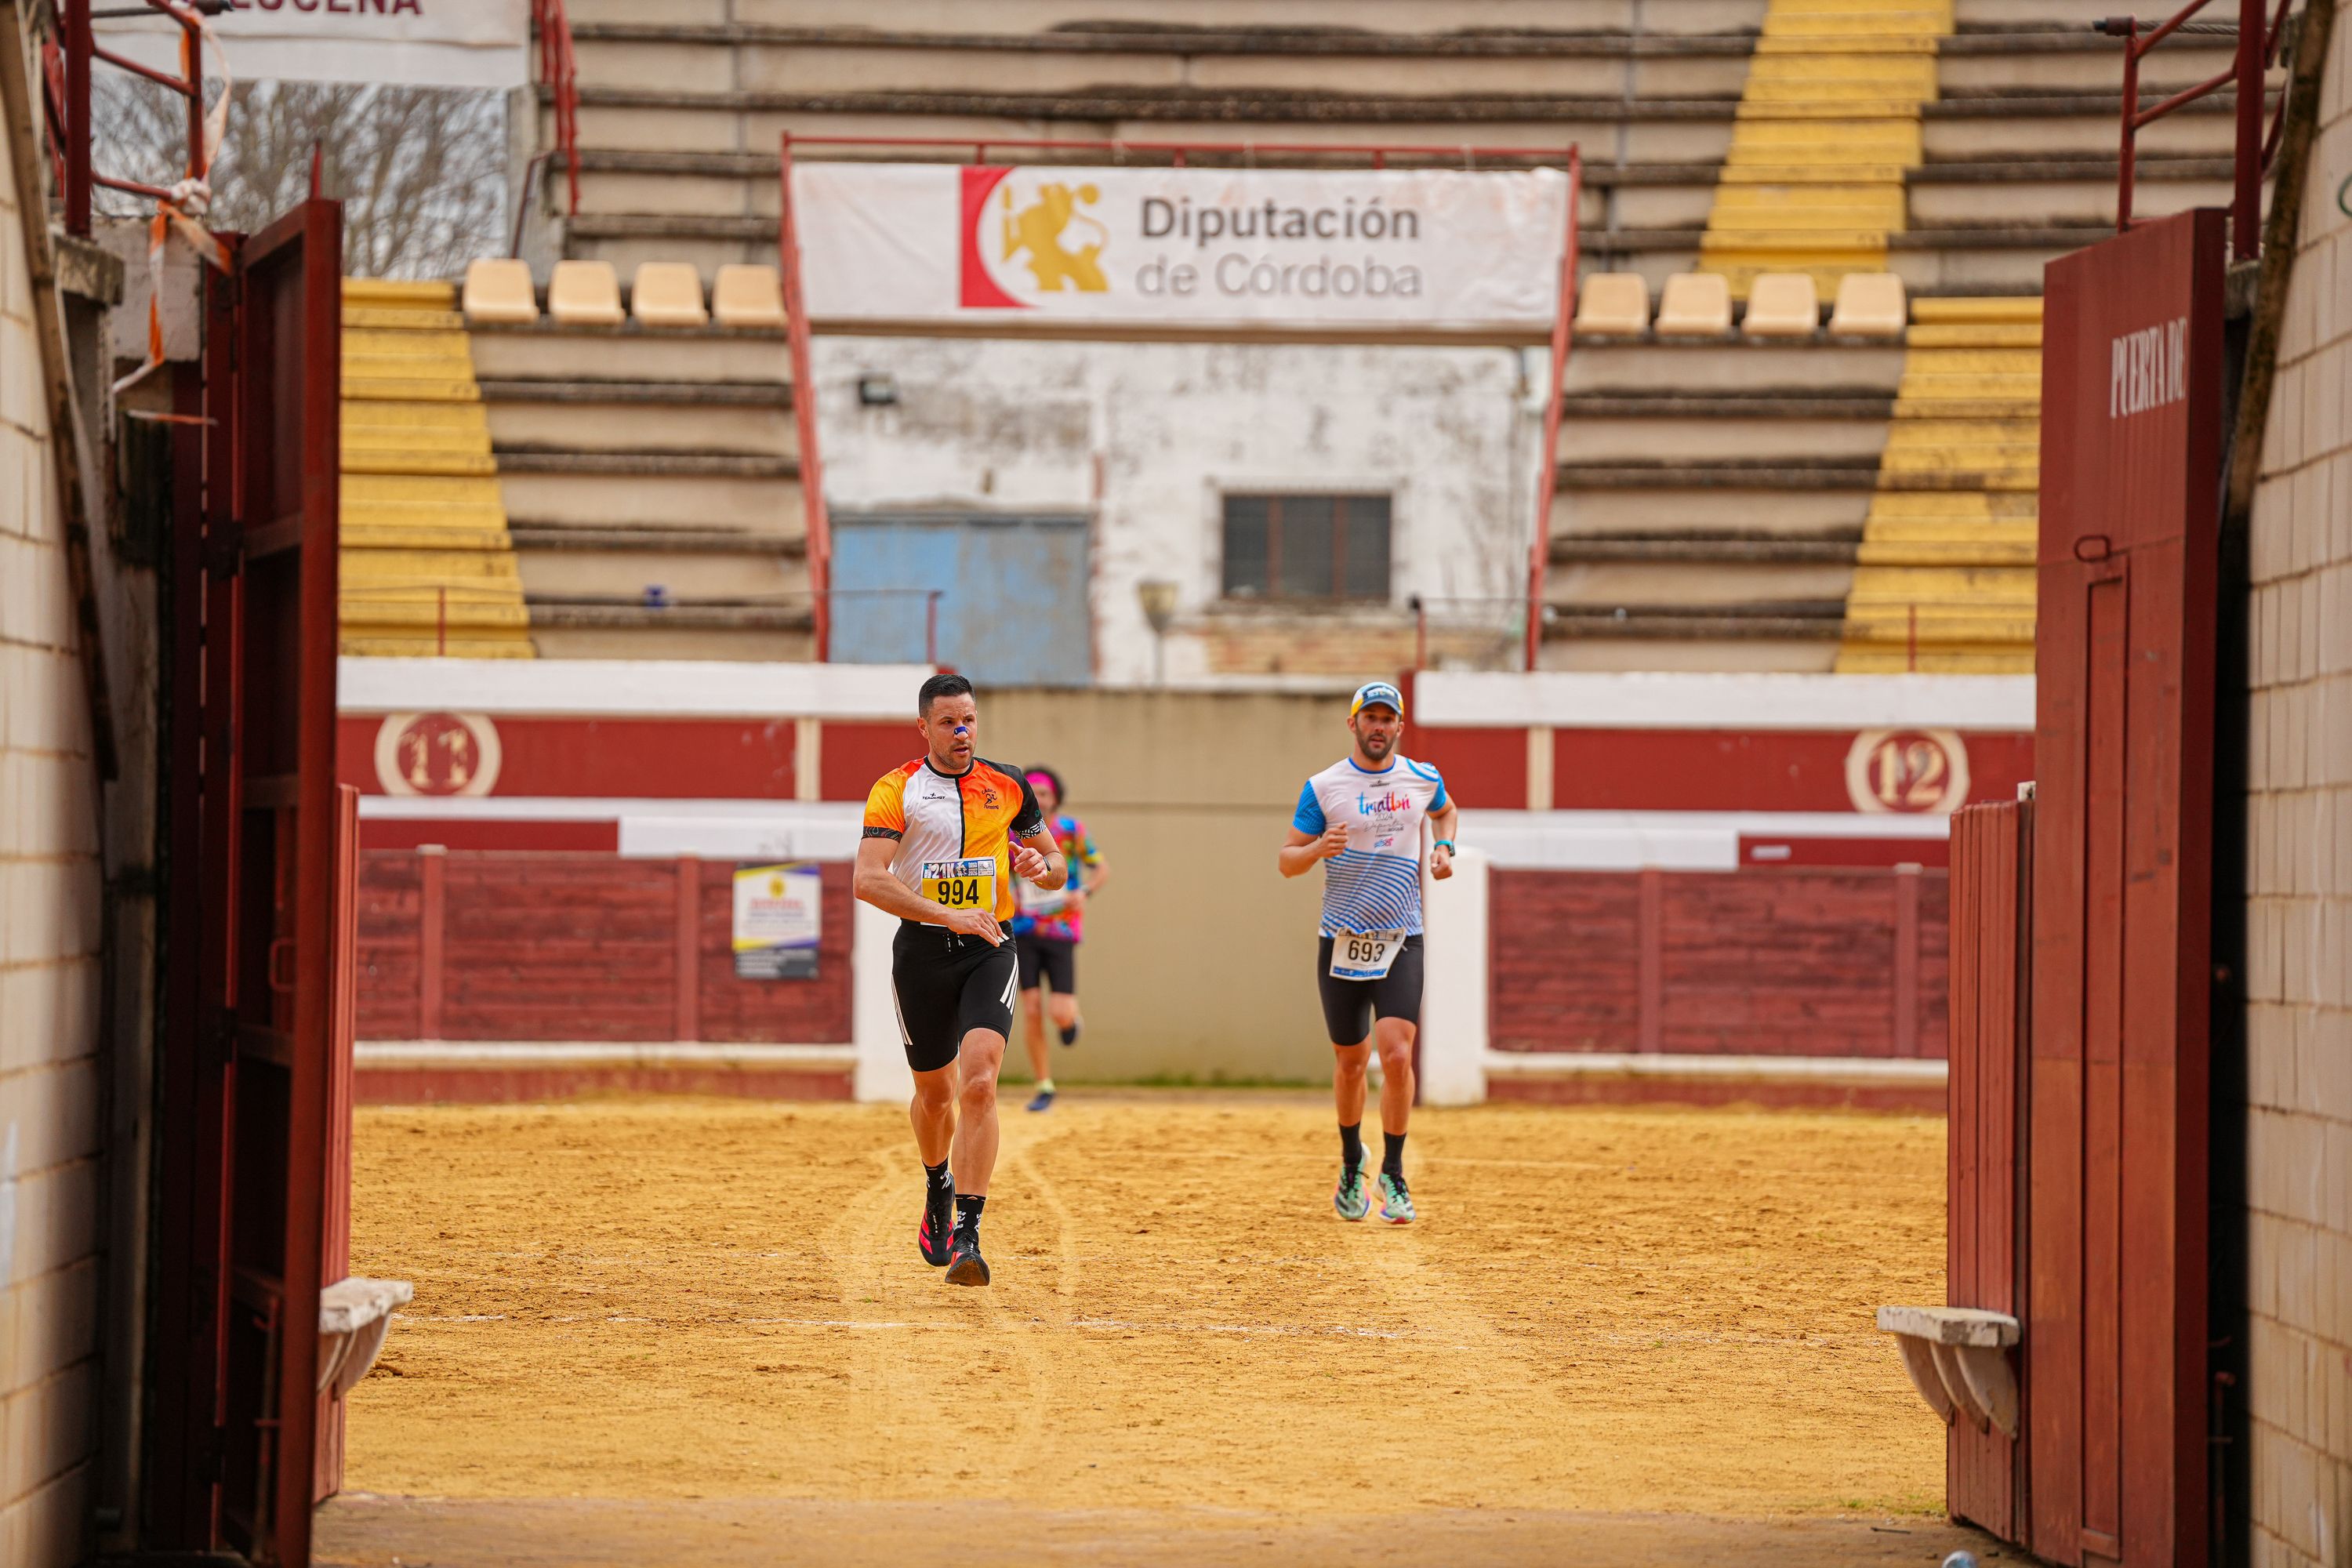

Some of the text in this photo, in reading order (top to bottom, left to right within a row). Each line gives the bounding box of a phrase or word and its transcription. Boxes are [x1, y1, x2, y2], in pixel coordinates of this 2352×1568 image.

[1142, 197, 1419, 248] Diputación
[1135, 252, 1422, 297] de Córdoba
[2111, 321, 2165, 418] PUERTA
[400, 728, 474, 789] 11
[1872, 739, 1945, 806] 12
[938, 879, 979, 906] 994
[1348, 939, 1385, 963] 693
